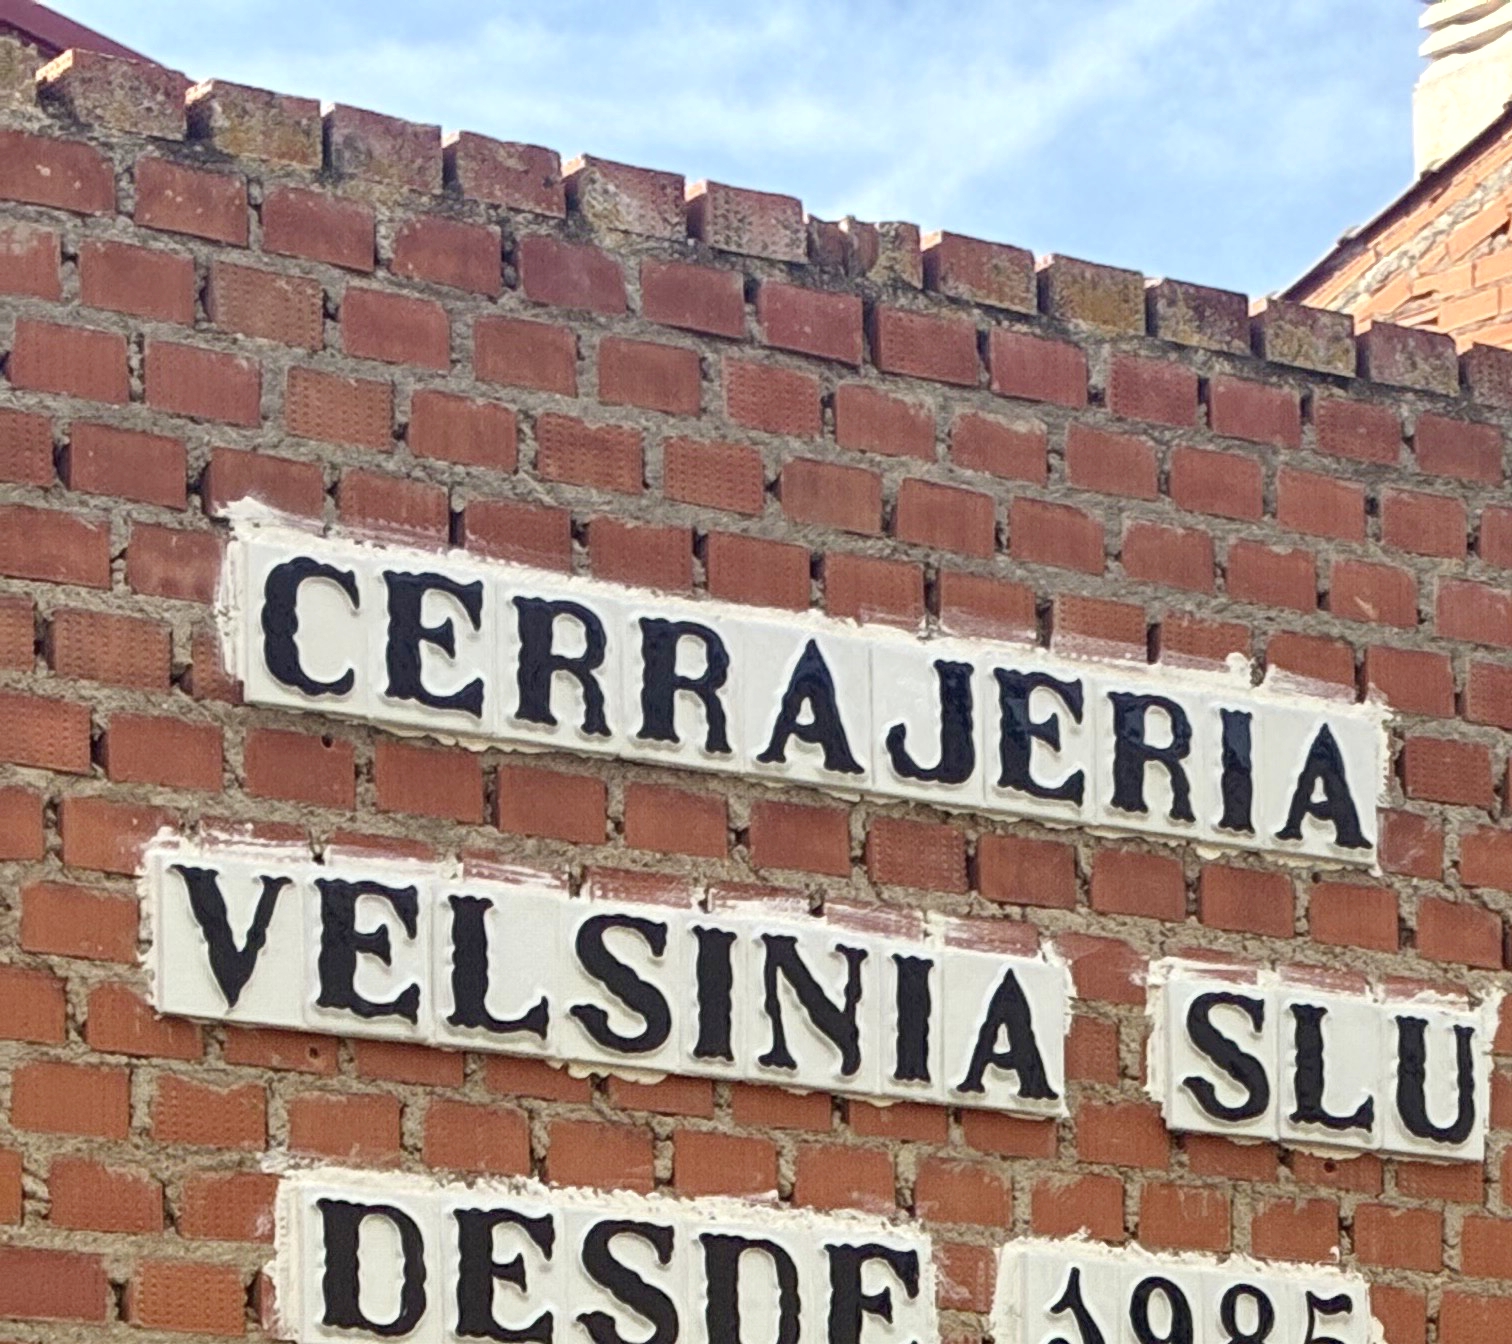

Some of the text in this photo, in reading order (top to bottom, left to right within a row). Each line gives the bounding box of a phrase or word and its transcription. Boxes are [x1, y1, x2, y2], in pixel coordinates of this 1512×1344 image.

[260, 555, 1374, 851] CERRAJERIA
[170, 863, 1476, 1146] VELSINIA SLU
